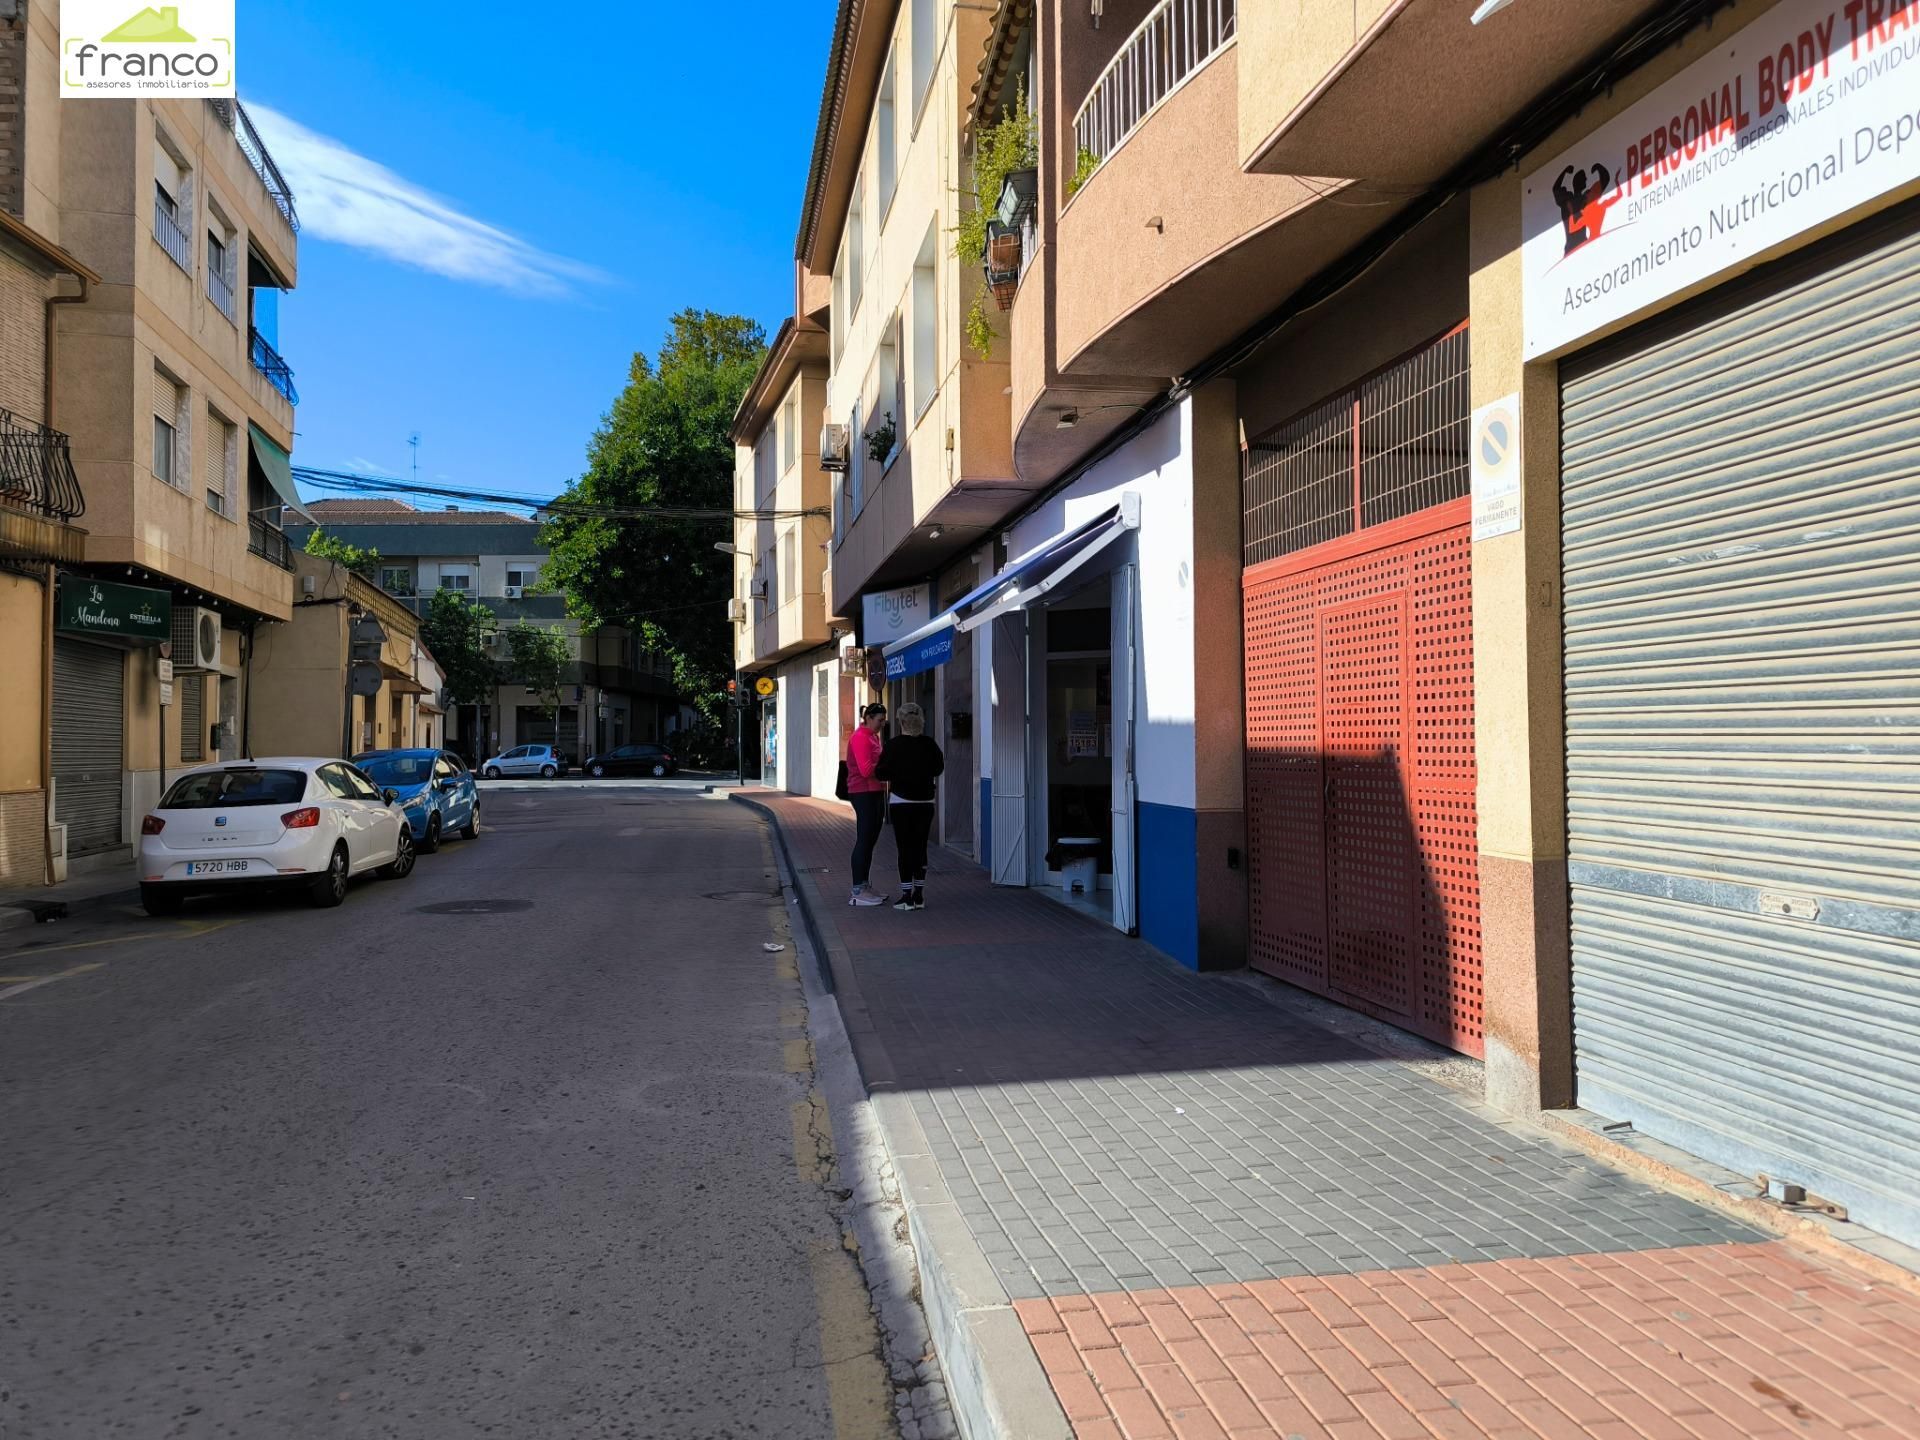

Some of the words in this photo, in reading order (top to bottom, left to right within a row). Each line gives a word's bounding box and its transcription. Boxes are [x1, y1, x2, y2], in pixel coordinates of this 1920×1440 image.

[1626, 74, 1750, 199] PERSONAL
[1758, 11, 1836, 118] BODY
[1627, 142, 1738, 222] ENTRENAMIENTOS
[1741, 84, 1835, 157] PERSONALES
[1562, 225, 1701, 316] Asesoramiento
[1709, 137, 1844, 240] Nutricional
[1487, 499, 1505, 512] VADO
[1475, 506, 1518, 526] PERMANENTE
[88, 584, 104, 604] La
[874, 588, 919, 617] Fibytel
[129, 613, 162, 623] ESTRELLA
[195, 862, 223, 874] 5720
[226, 860, 248, 872] HBB
